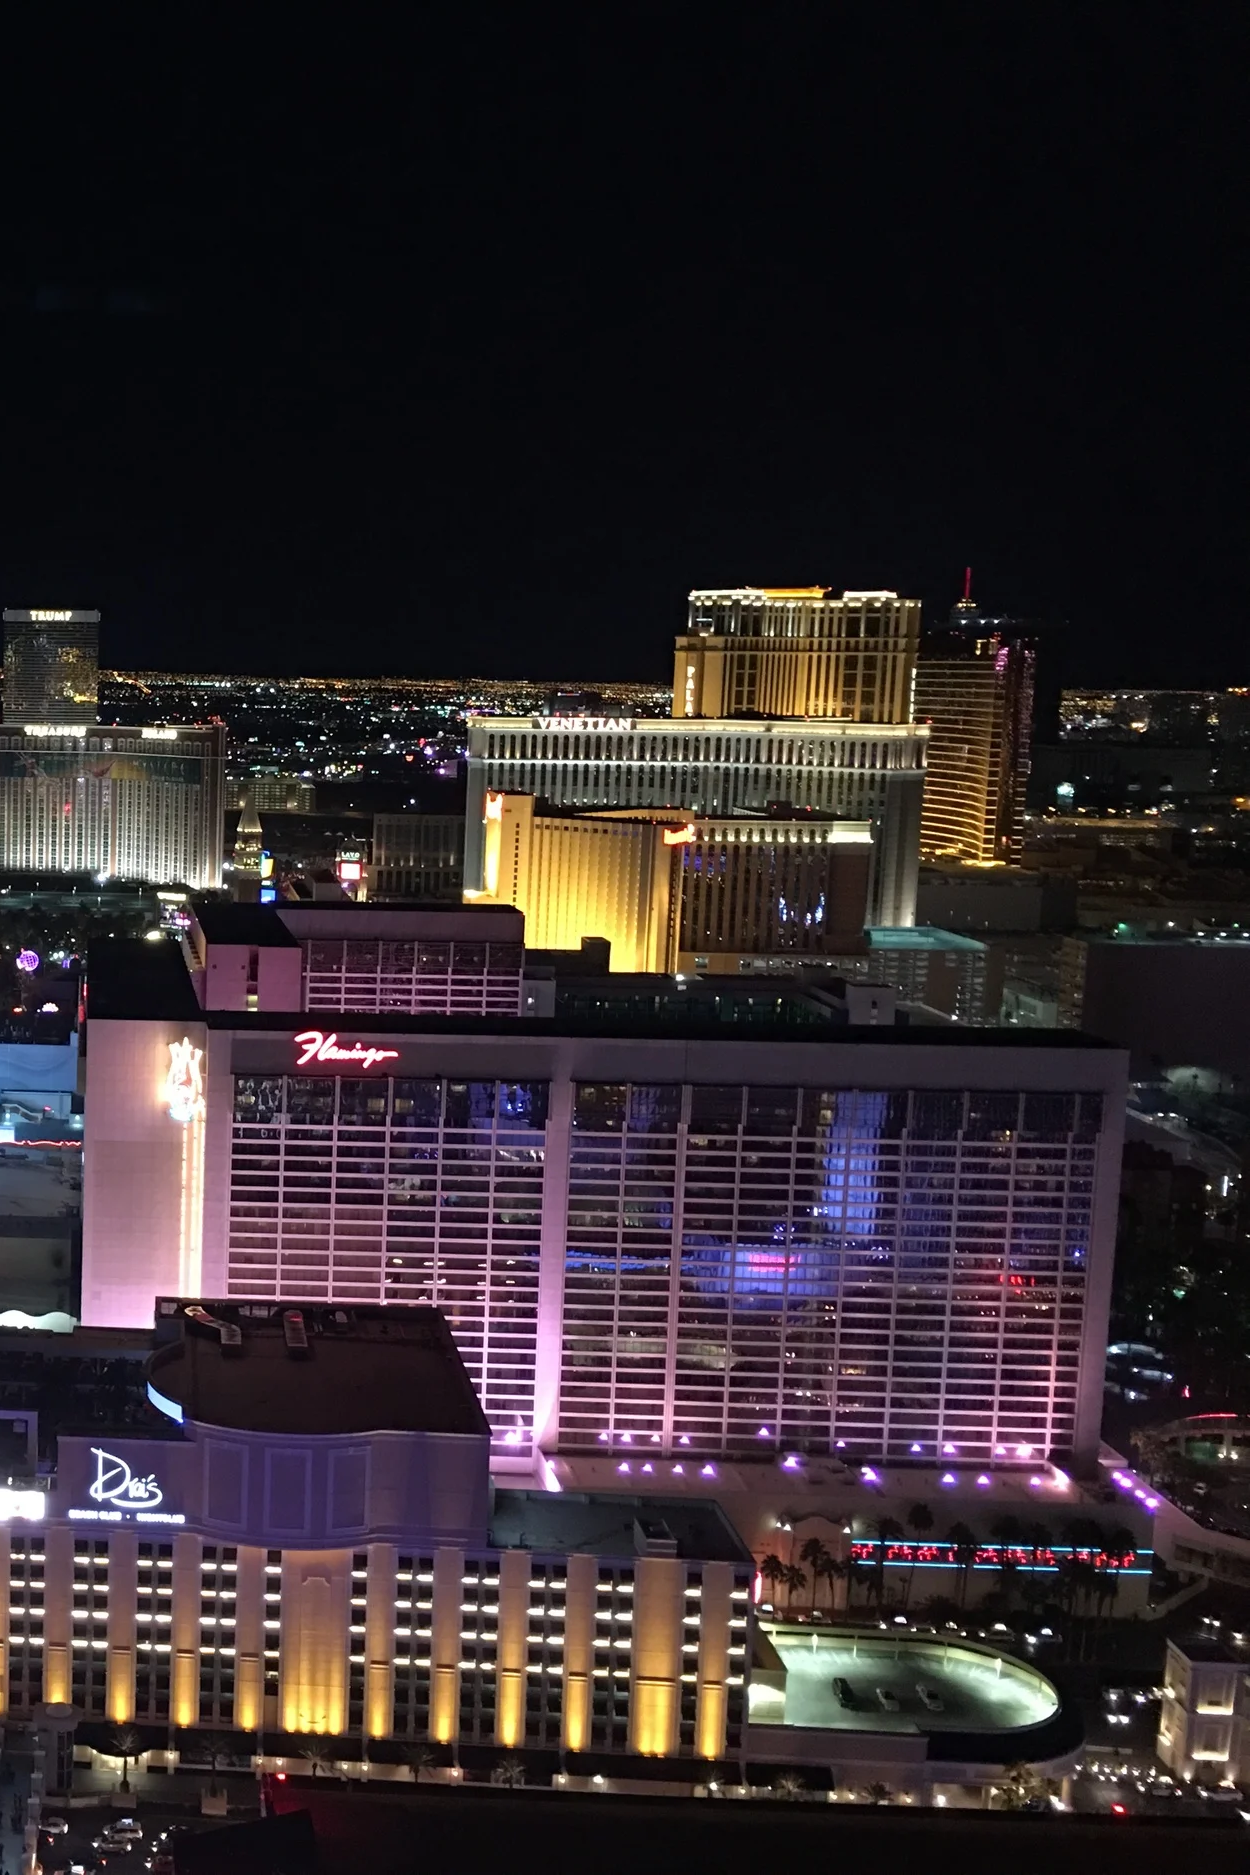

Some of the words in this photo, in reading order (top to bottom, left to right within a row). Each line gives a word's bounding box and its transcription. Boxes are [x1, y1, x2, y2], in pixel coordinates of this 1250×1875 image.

[30, 610, 72, 621] TRUMP
[537, 717, 633, 731] VENETIAN
[294, 1031, 399, 1068] Flamingo
